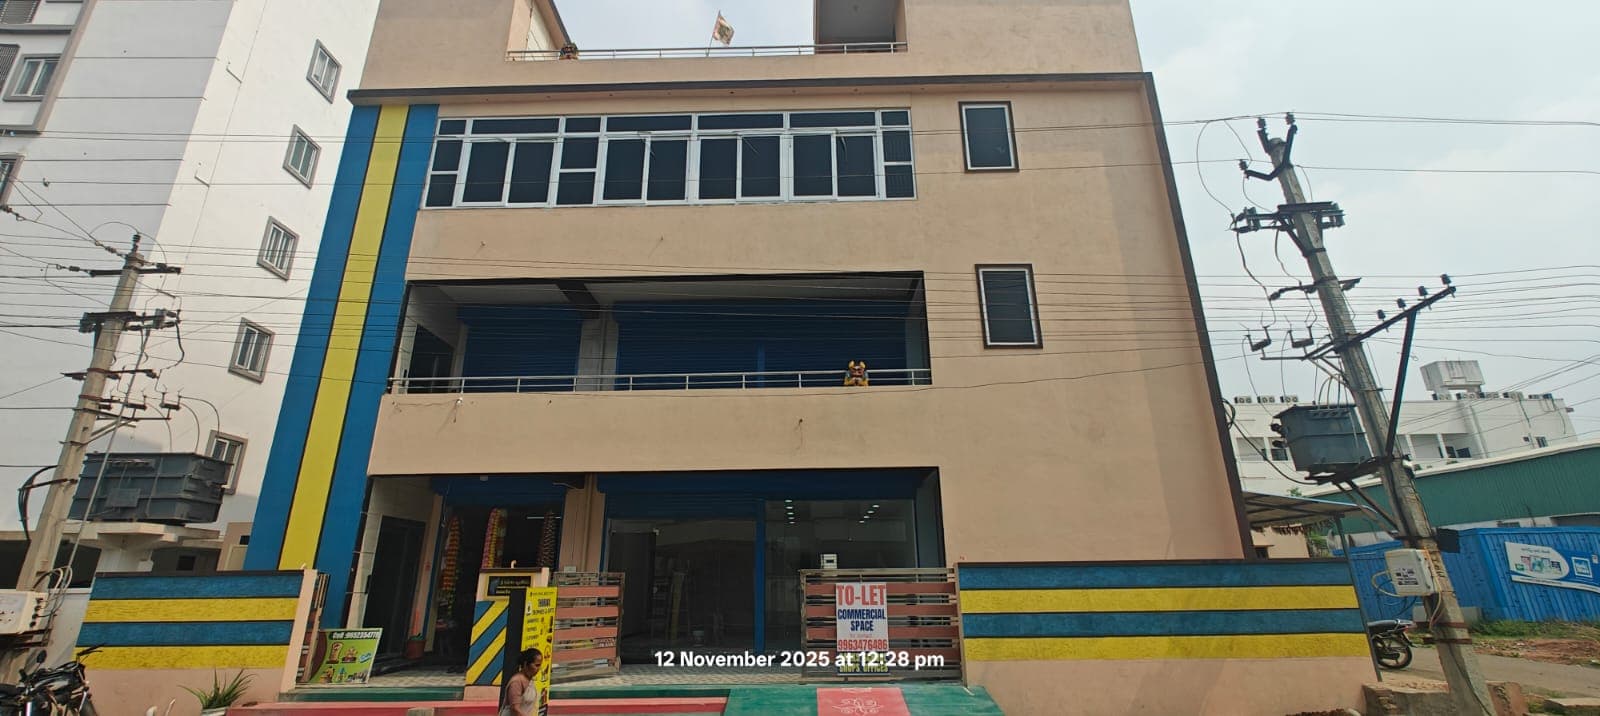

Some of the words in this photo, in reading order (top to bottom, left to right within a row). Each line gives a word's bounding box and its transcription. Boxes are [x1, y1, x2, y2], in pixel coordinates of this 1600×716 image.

[837, 585, 885, 605] TO-LET
[838, 608, 886, 620] COMMERCIAL
[850, 620, 874, 631] SPACE
[838, 639, 888, 650] 9963476486
